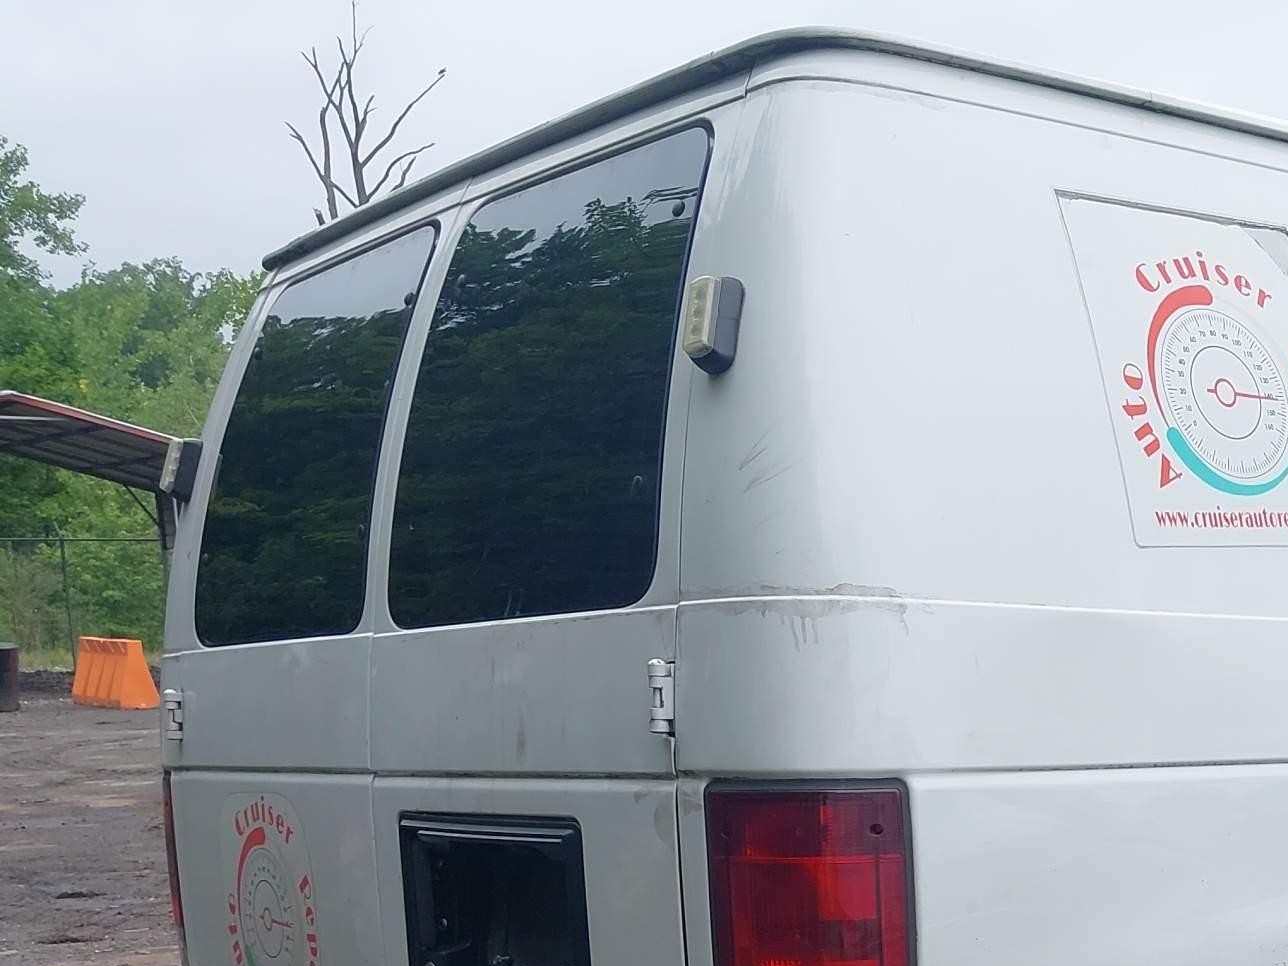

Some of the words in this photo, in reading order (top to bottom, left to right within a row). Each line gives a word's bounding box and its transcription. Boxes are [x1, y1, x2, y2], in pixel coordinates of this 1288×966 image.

[1135, 251, 1273, 308] Cruiser
[1122, 363, 1183, 489] Auto
[1265, 423, 1275, 431] 160
[235, 795, 294, 844] Cruiser
